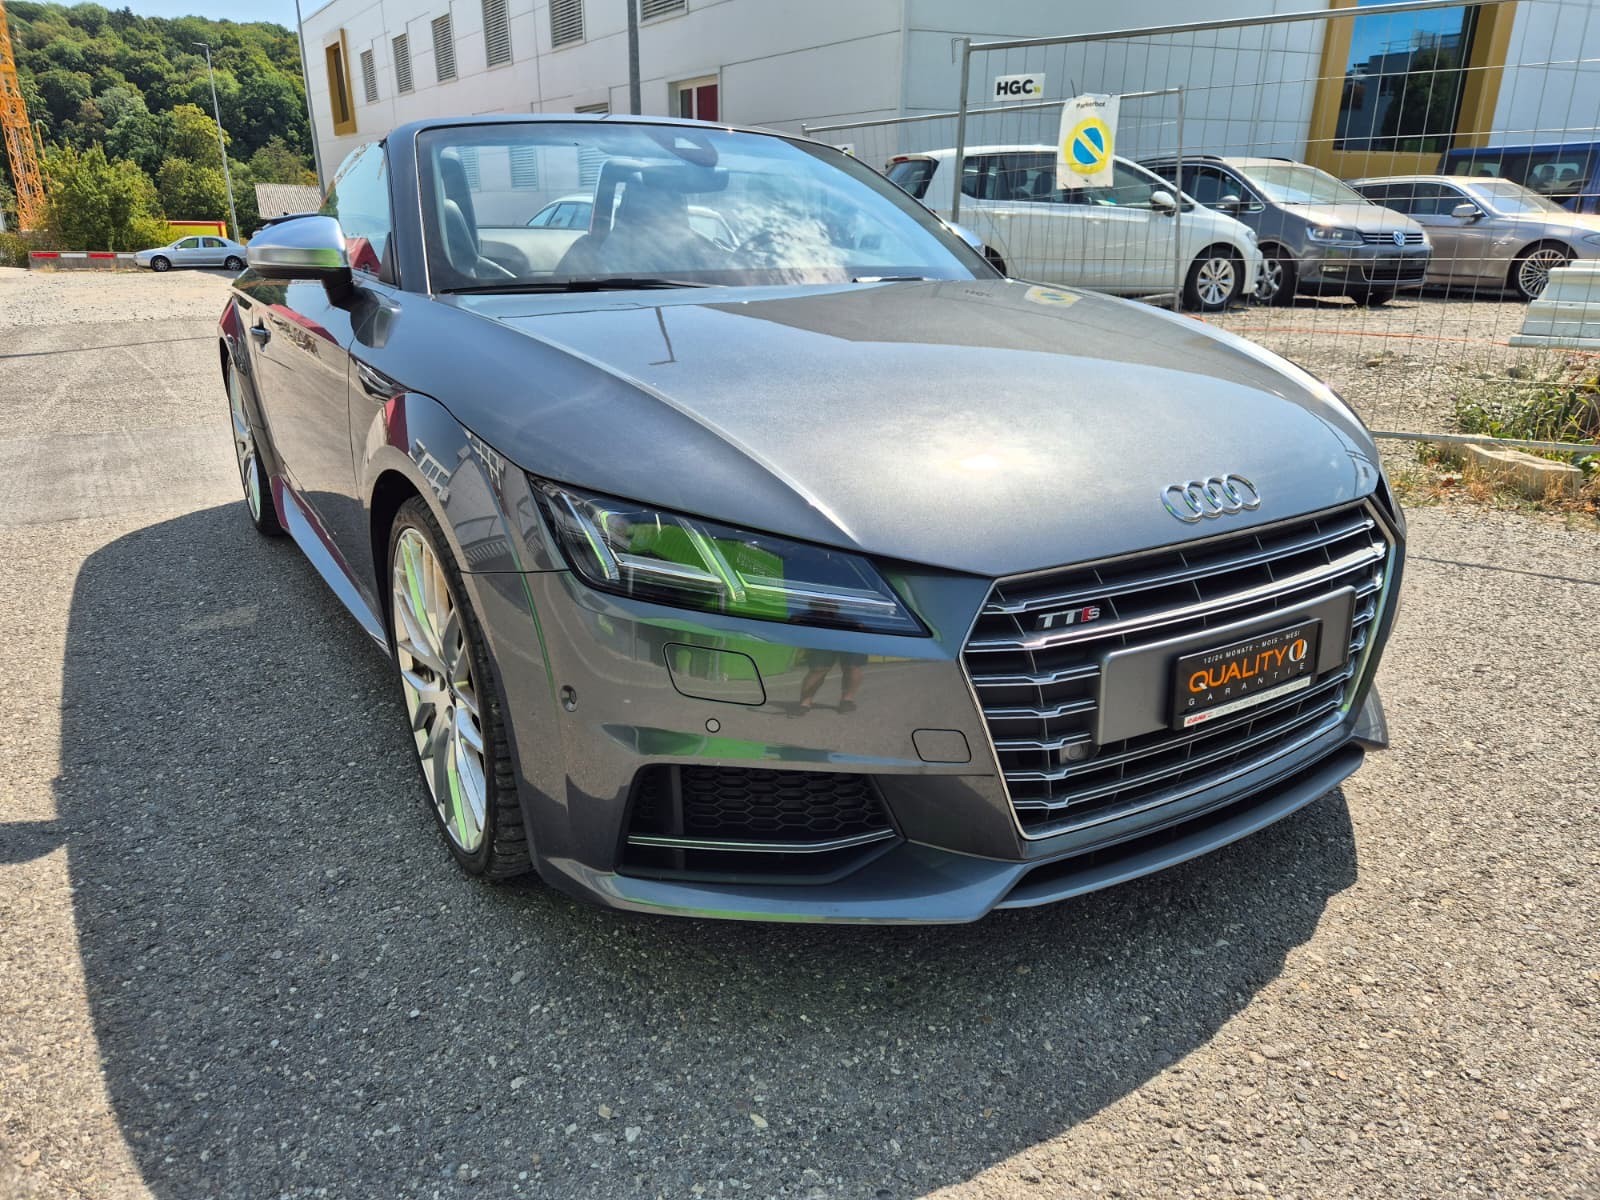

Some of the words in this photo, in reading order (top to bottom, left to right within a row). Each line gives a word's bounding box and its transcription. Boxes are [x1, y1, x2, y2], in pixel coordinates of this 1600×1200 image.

[996, 79, 1034, 96] HGC
[1039, 606, 1101, 629] TTS
[1203, 654, 1223, 664] 12/24
[1225, 645, 1253, 658] MONATE
[1261, 638, 1278, 647] MOIS
[1188, 645, 1289, 692] QUALITY
